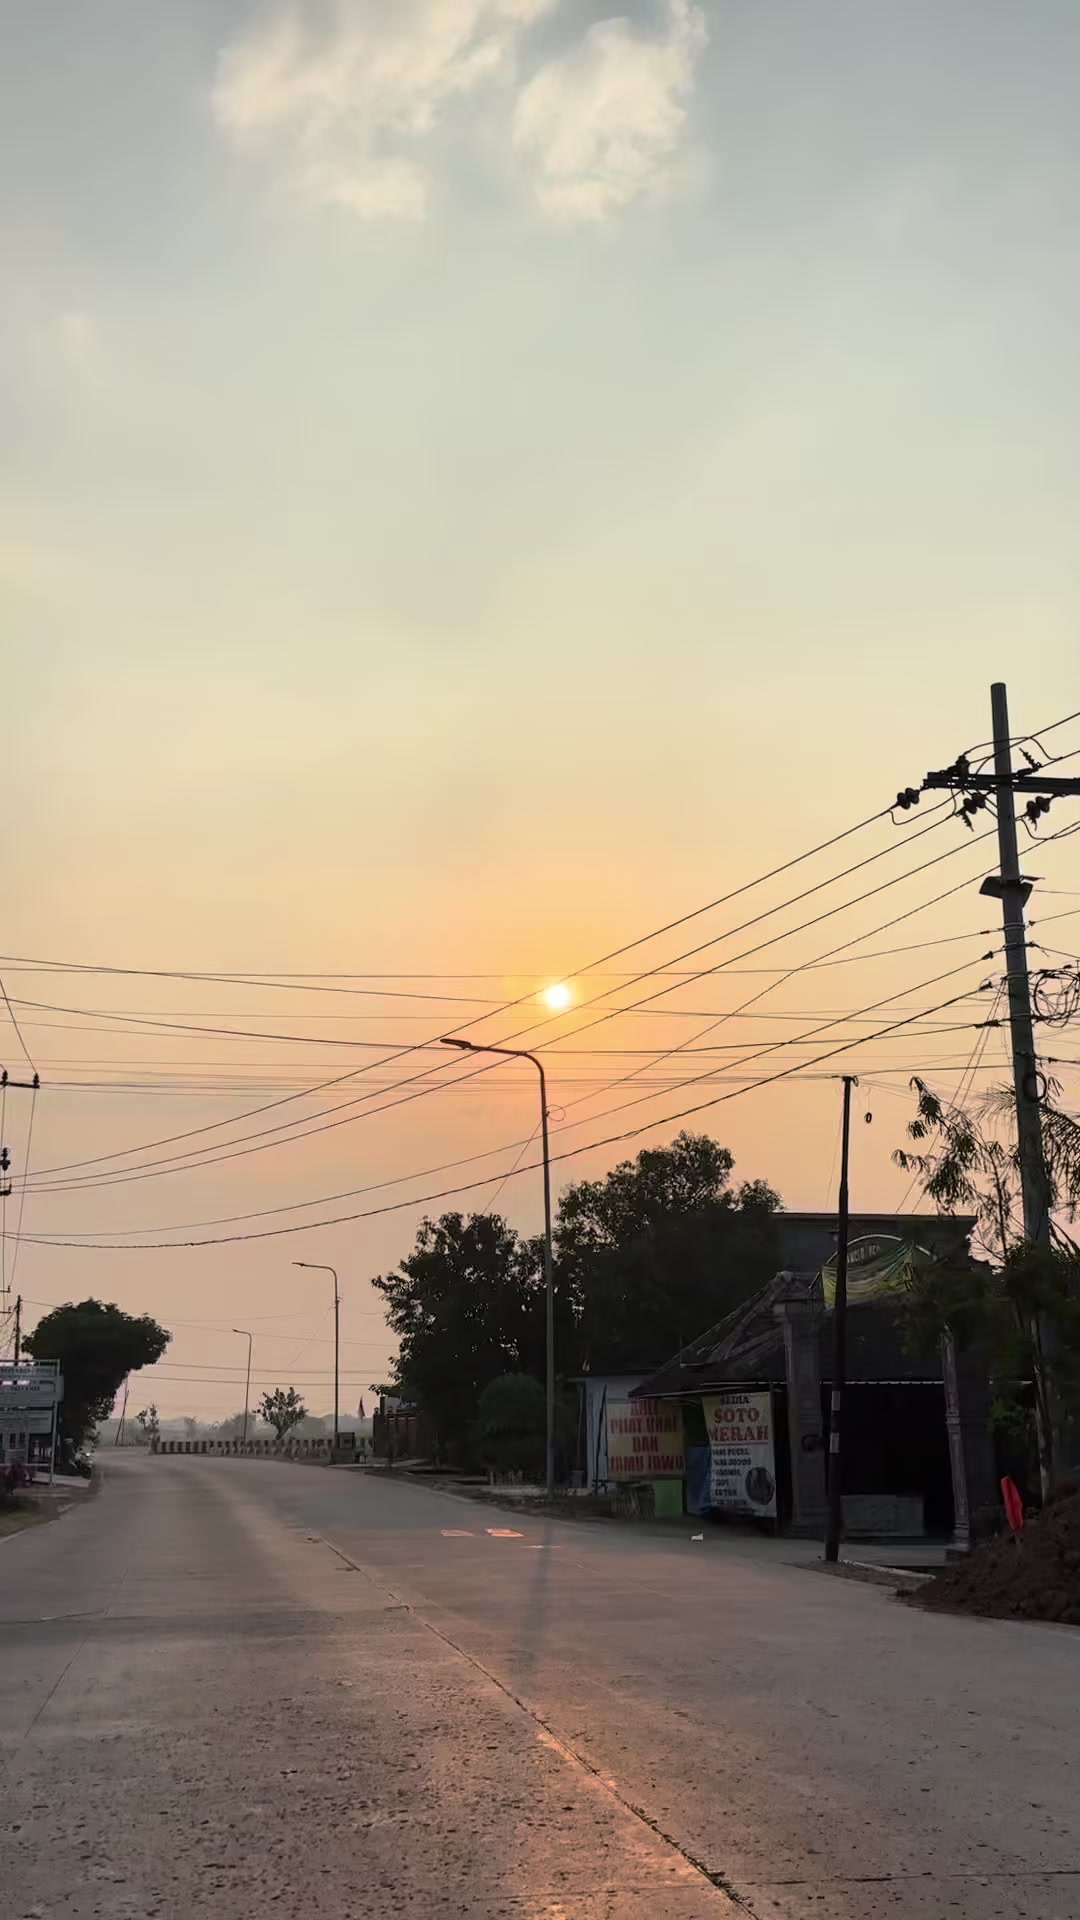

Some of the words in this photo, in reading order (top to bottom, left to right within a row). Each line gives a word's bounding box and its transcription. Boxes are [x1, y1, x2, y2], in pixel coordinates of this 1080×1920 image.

[720, 1394, 751, 1405] SEDIA
[714, 1407, 760, 1423] SOTO
[708, 1425, 769, 1441] MERAH
[632, 1435, 659, 1453] DAN
